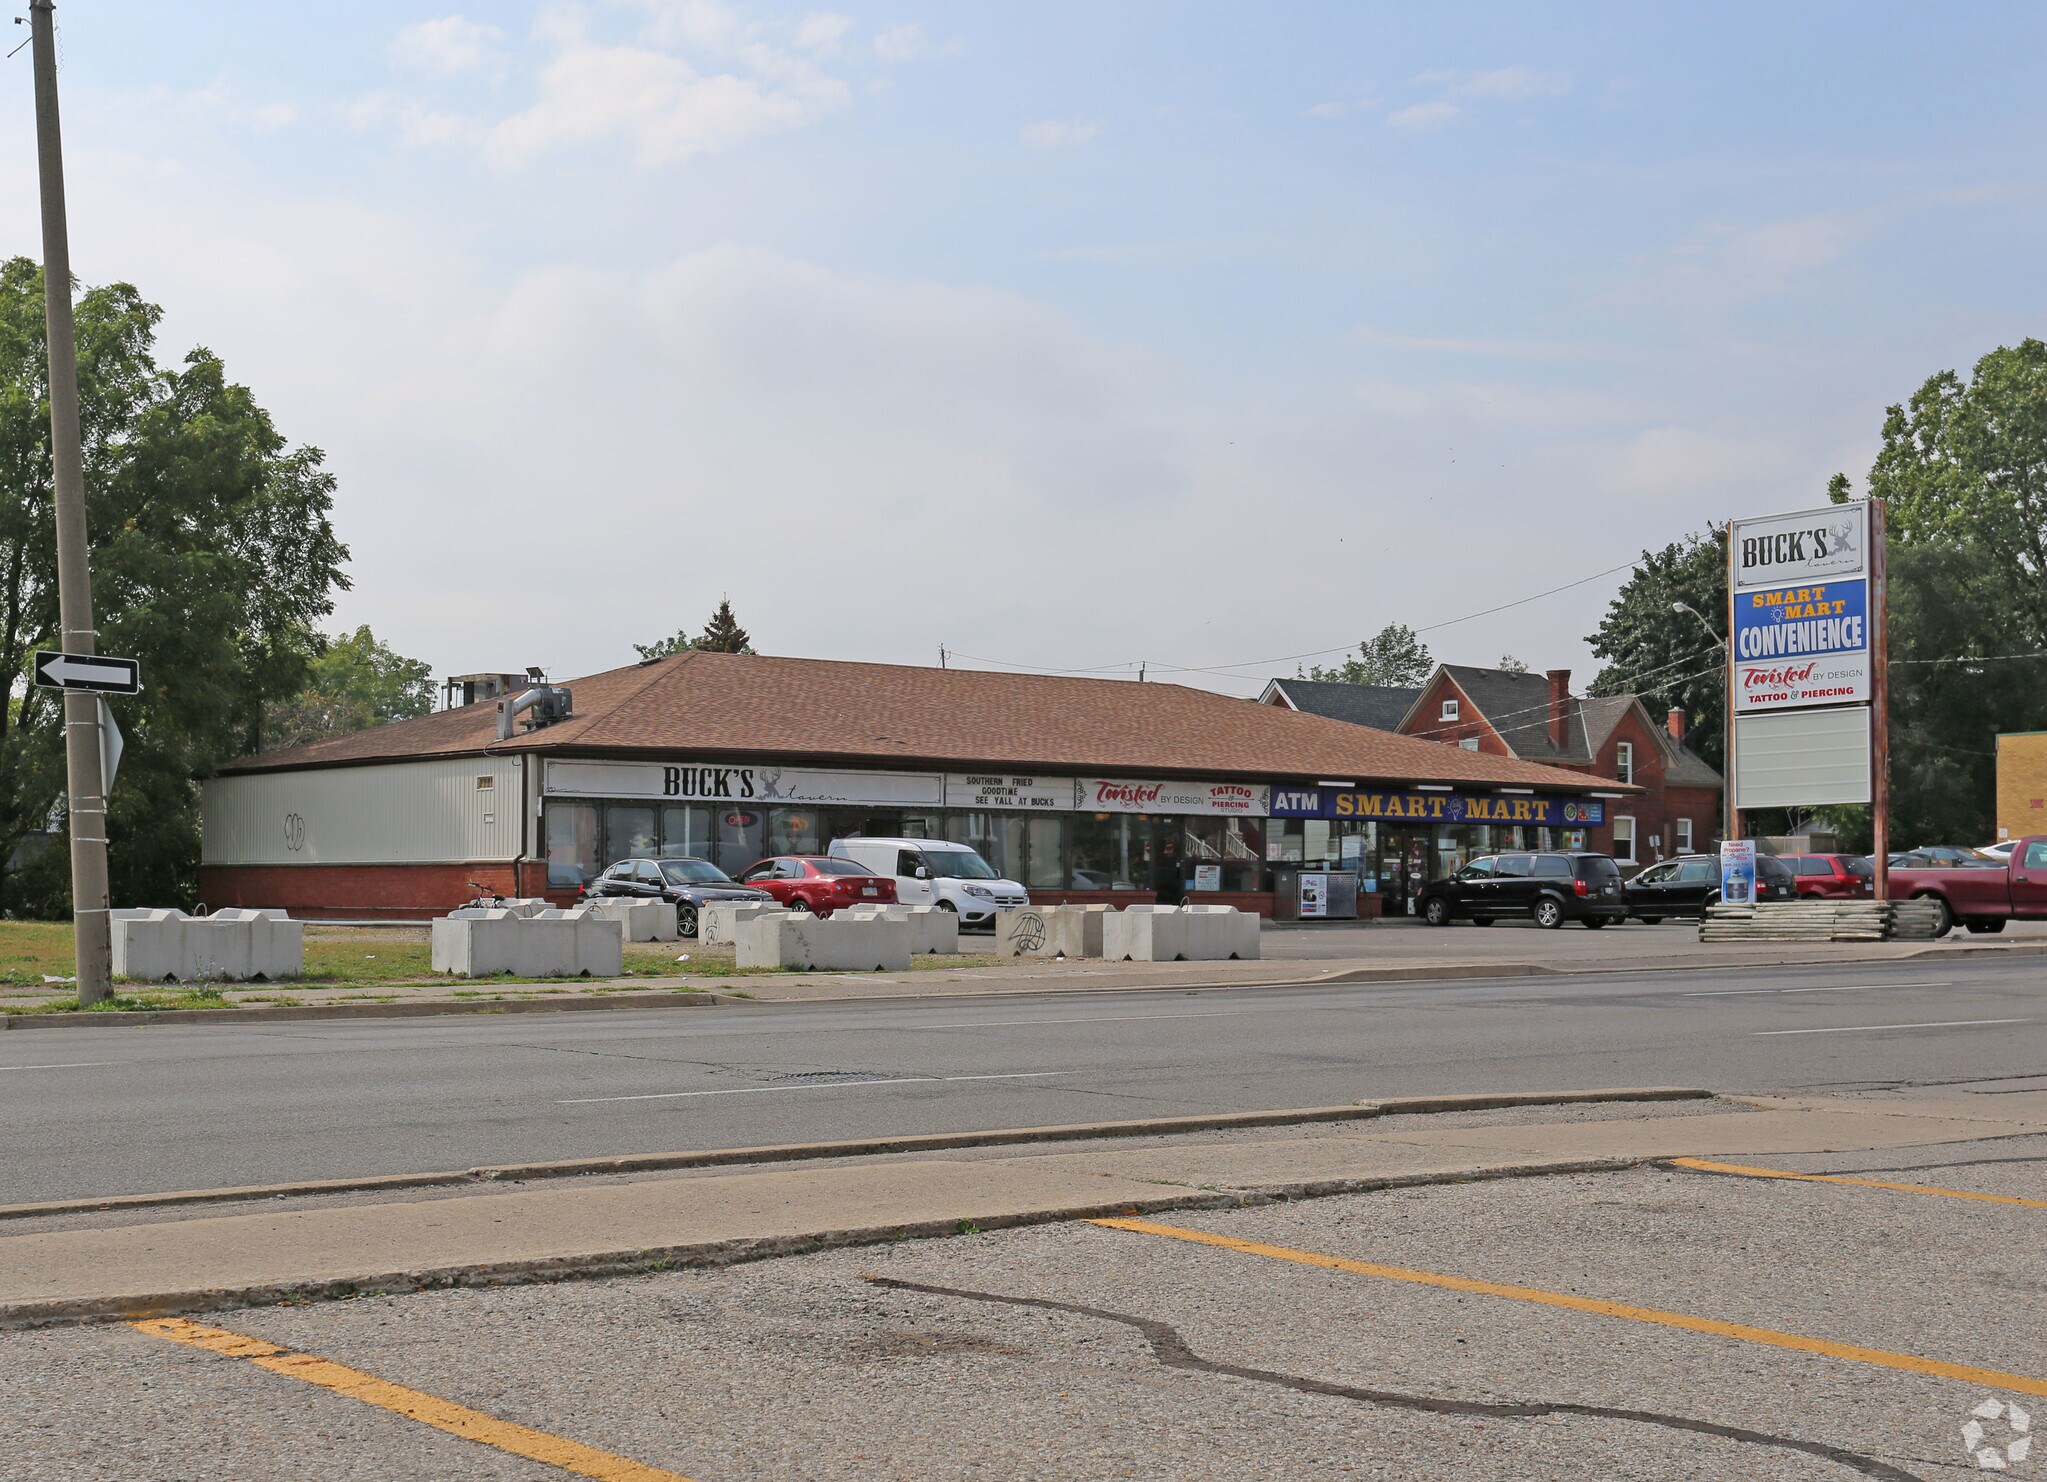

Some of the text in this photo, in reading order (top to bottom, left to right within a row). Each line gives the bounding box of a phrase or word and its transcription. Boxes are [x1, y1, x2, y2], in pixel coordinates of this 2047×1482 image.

[1742, 528, 1828, 568] BUCK'S
[1752, 587, 1825, 608] SMART
[1784, 600, 1845, 620] MART
[1739, 615, 1862, 658] CONVENIENCE
[1742, 662, 1863, 690] Twisted BY DESIGN
[1749, 692, 1788, 703] TATTOO
[1801, 687, 1854, 699] PIERCING
[662, 766, 755, 798] BUCK'S
[966, 776, 1033, 787] SOUTHERN FRIED
[982, 787, 1018, 796] GOODTIME
[975, 796, 1055, 807] SEE YALL AT BUCKS
[1095, 781, 1204, 808] Twisted BY DESIGN
[1210, 786, 1252, 798] TATTOO
[1274, 792, 1318, 811] ATM
[1212, 801, 1250, 809] PIERCING
[1336, 793, 1549, 821] SMART MART
